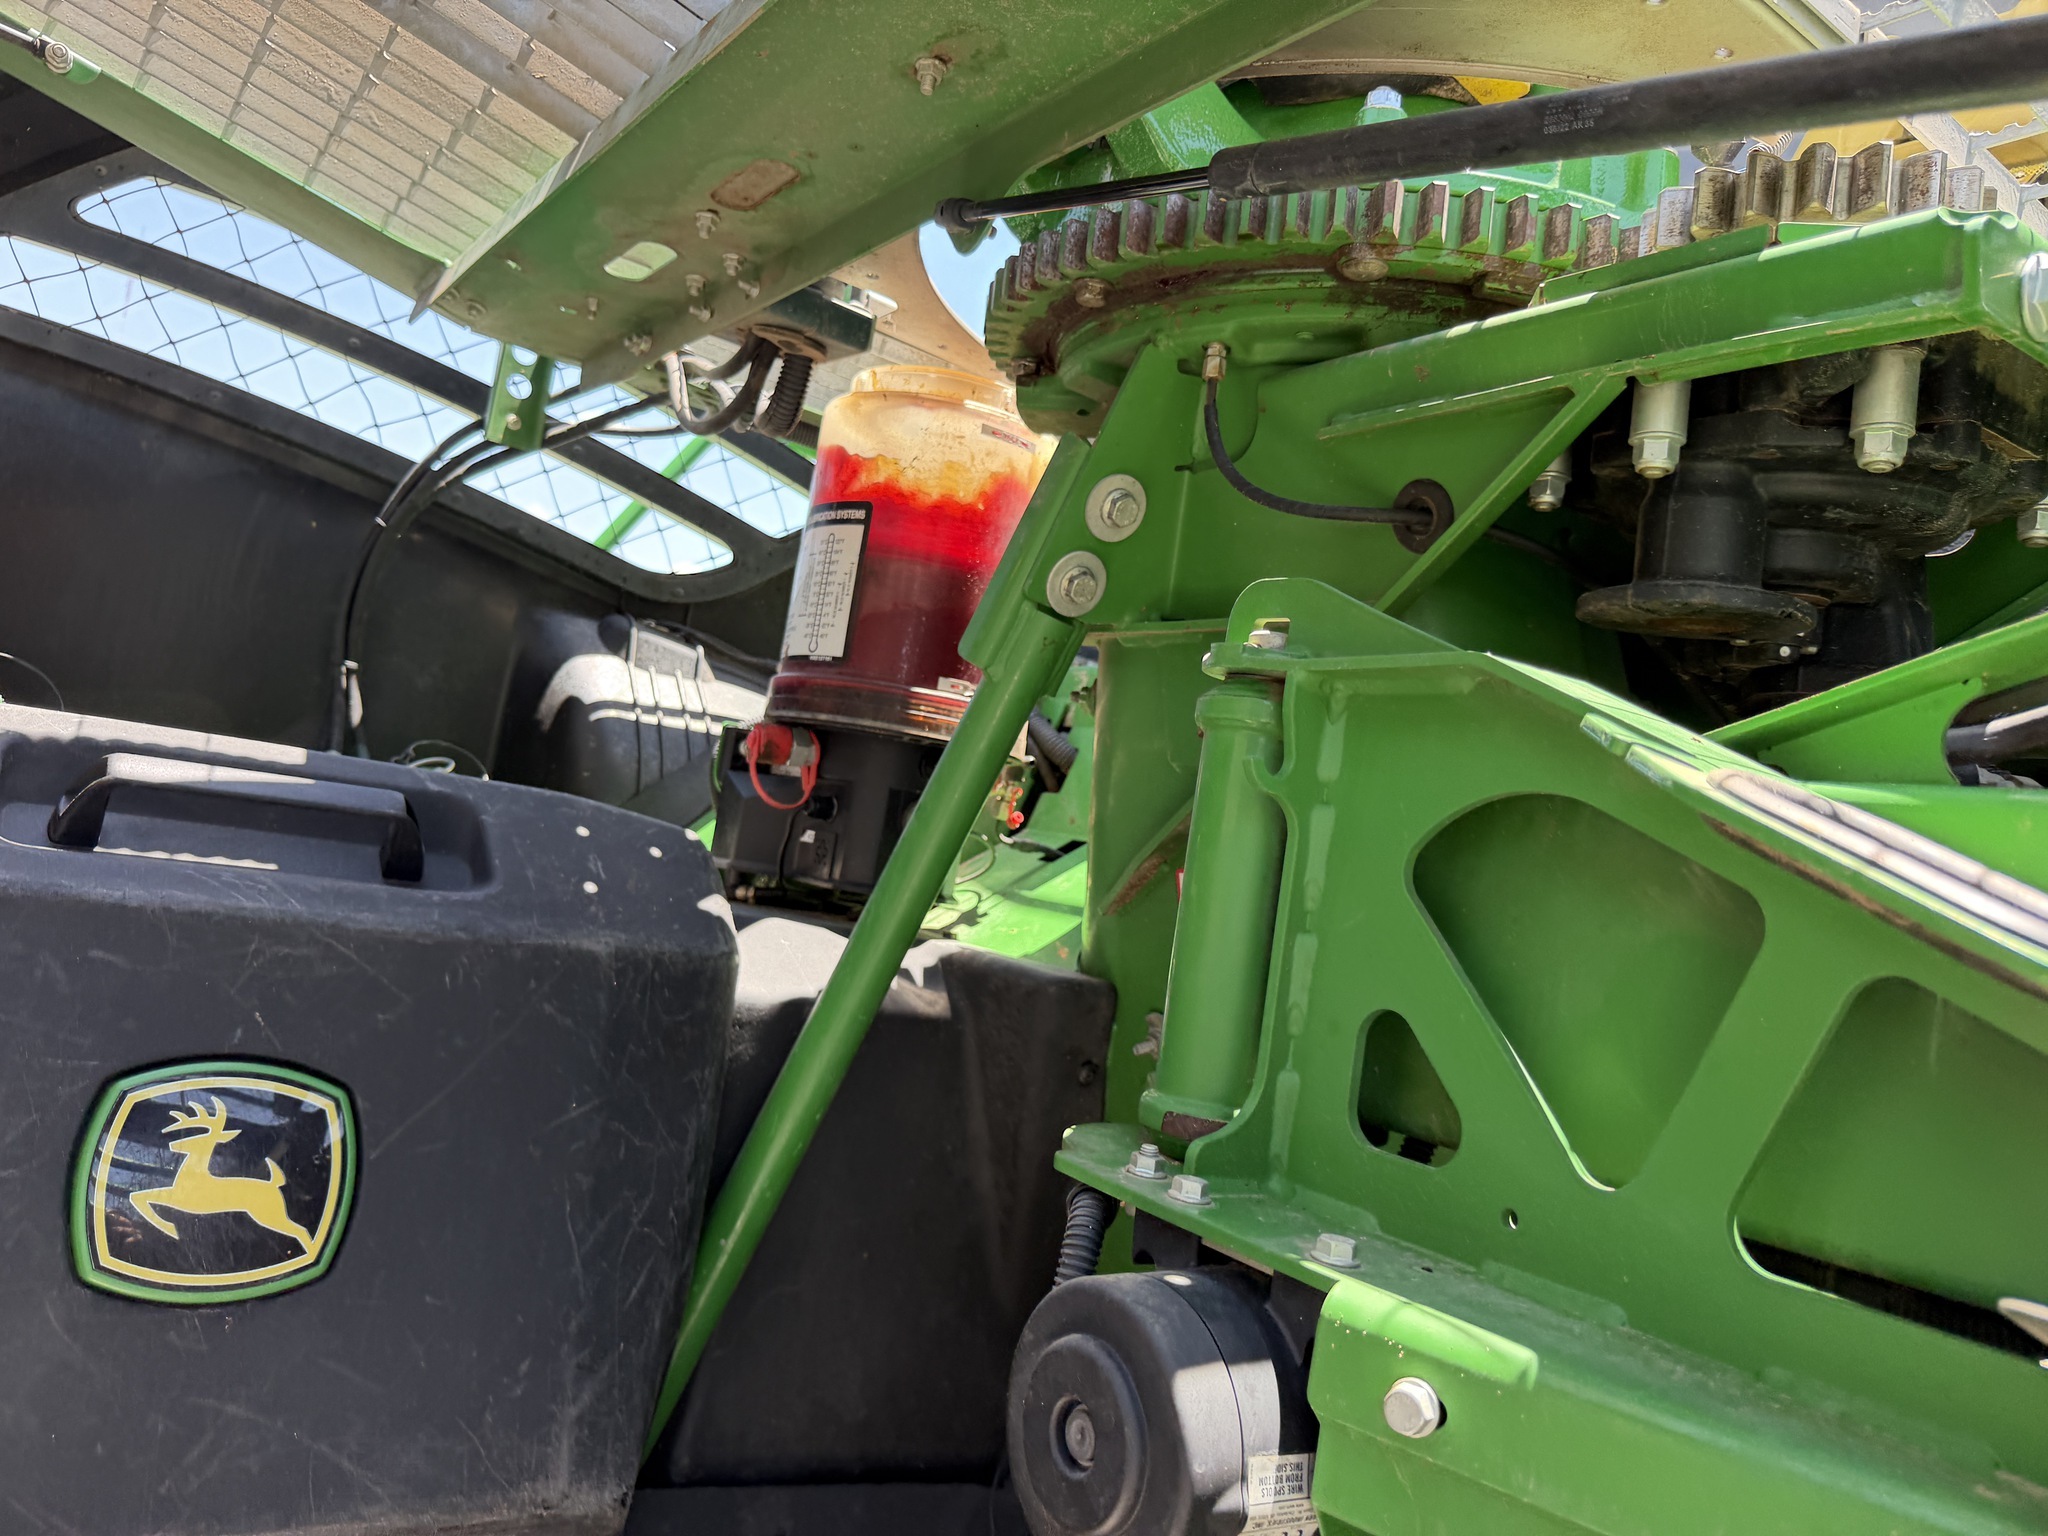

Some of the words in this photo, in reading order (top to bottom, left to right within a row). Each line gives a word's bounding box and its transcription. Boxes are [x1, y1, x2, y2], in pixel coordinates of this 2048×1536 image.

[837, 508, 866, 520] SYSTEMS
[1289, 1462, 1303, 1472] THIS
[1258, 1474, 1284, 1486] BOTTOM
[1285, 1473, 1303, 1484] FROM
[1261, 1485, 1286, 1498] SPOOLS
[1287, 1484, 1304, 1495] WIRE
